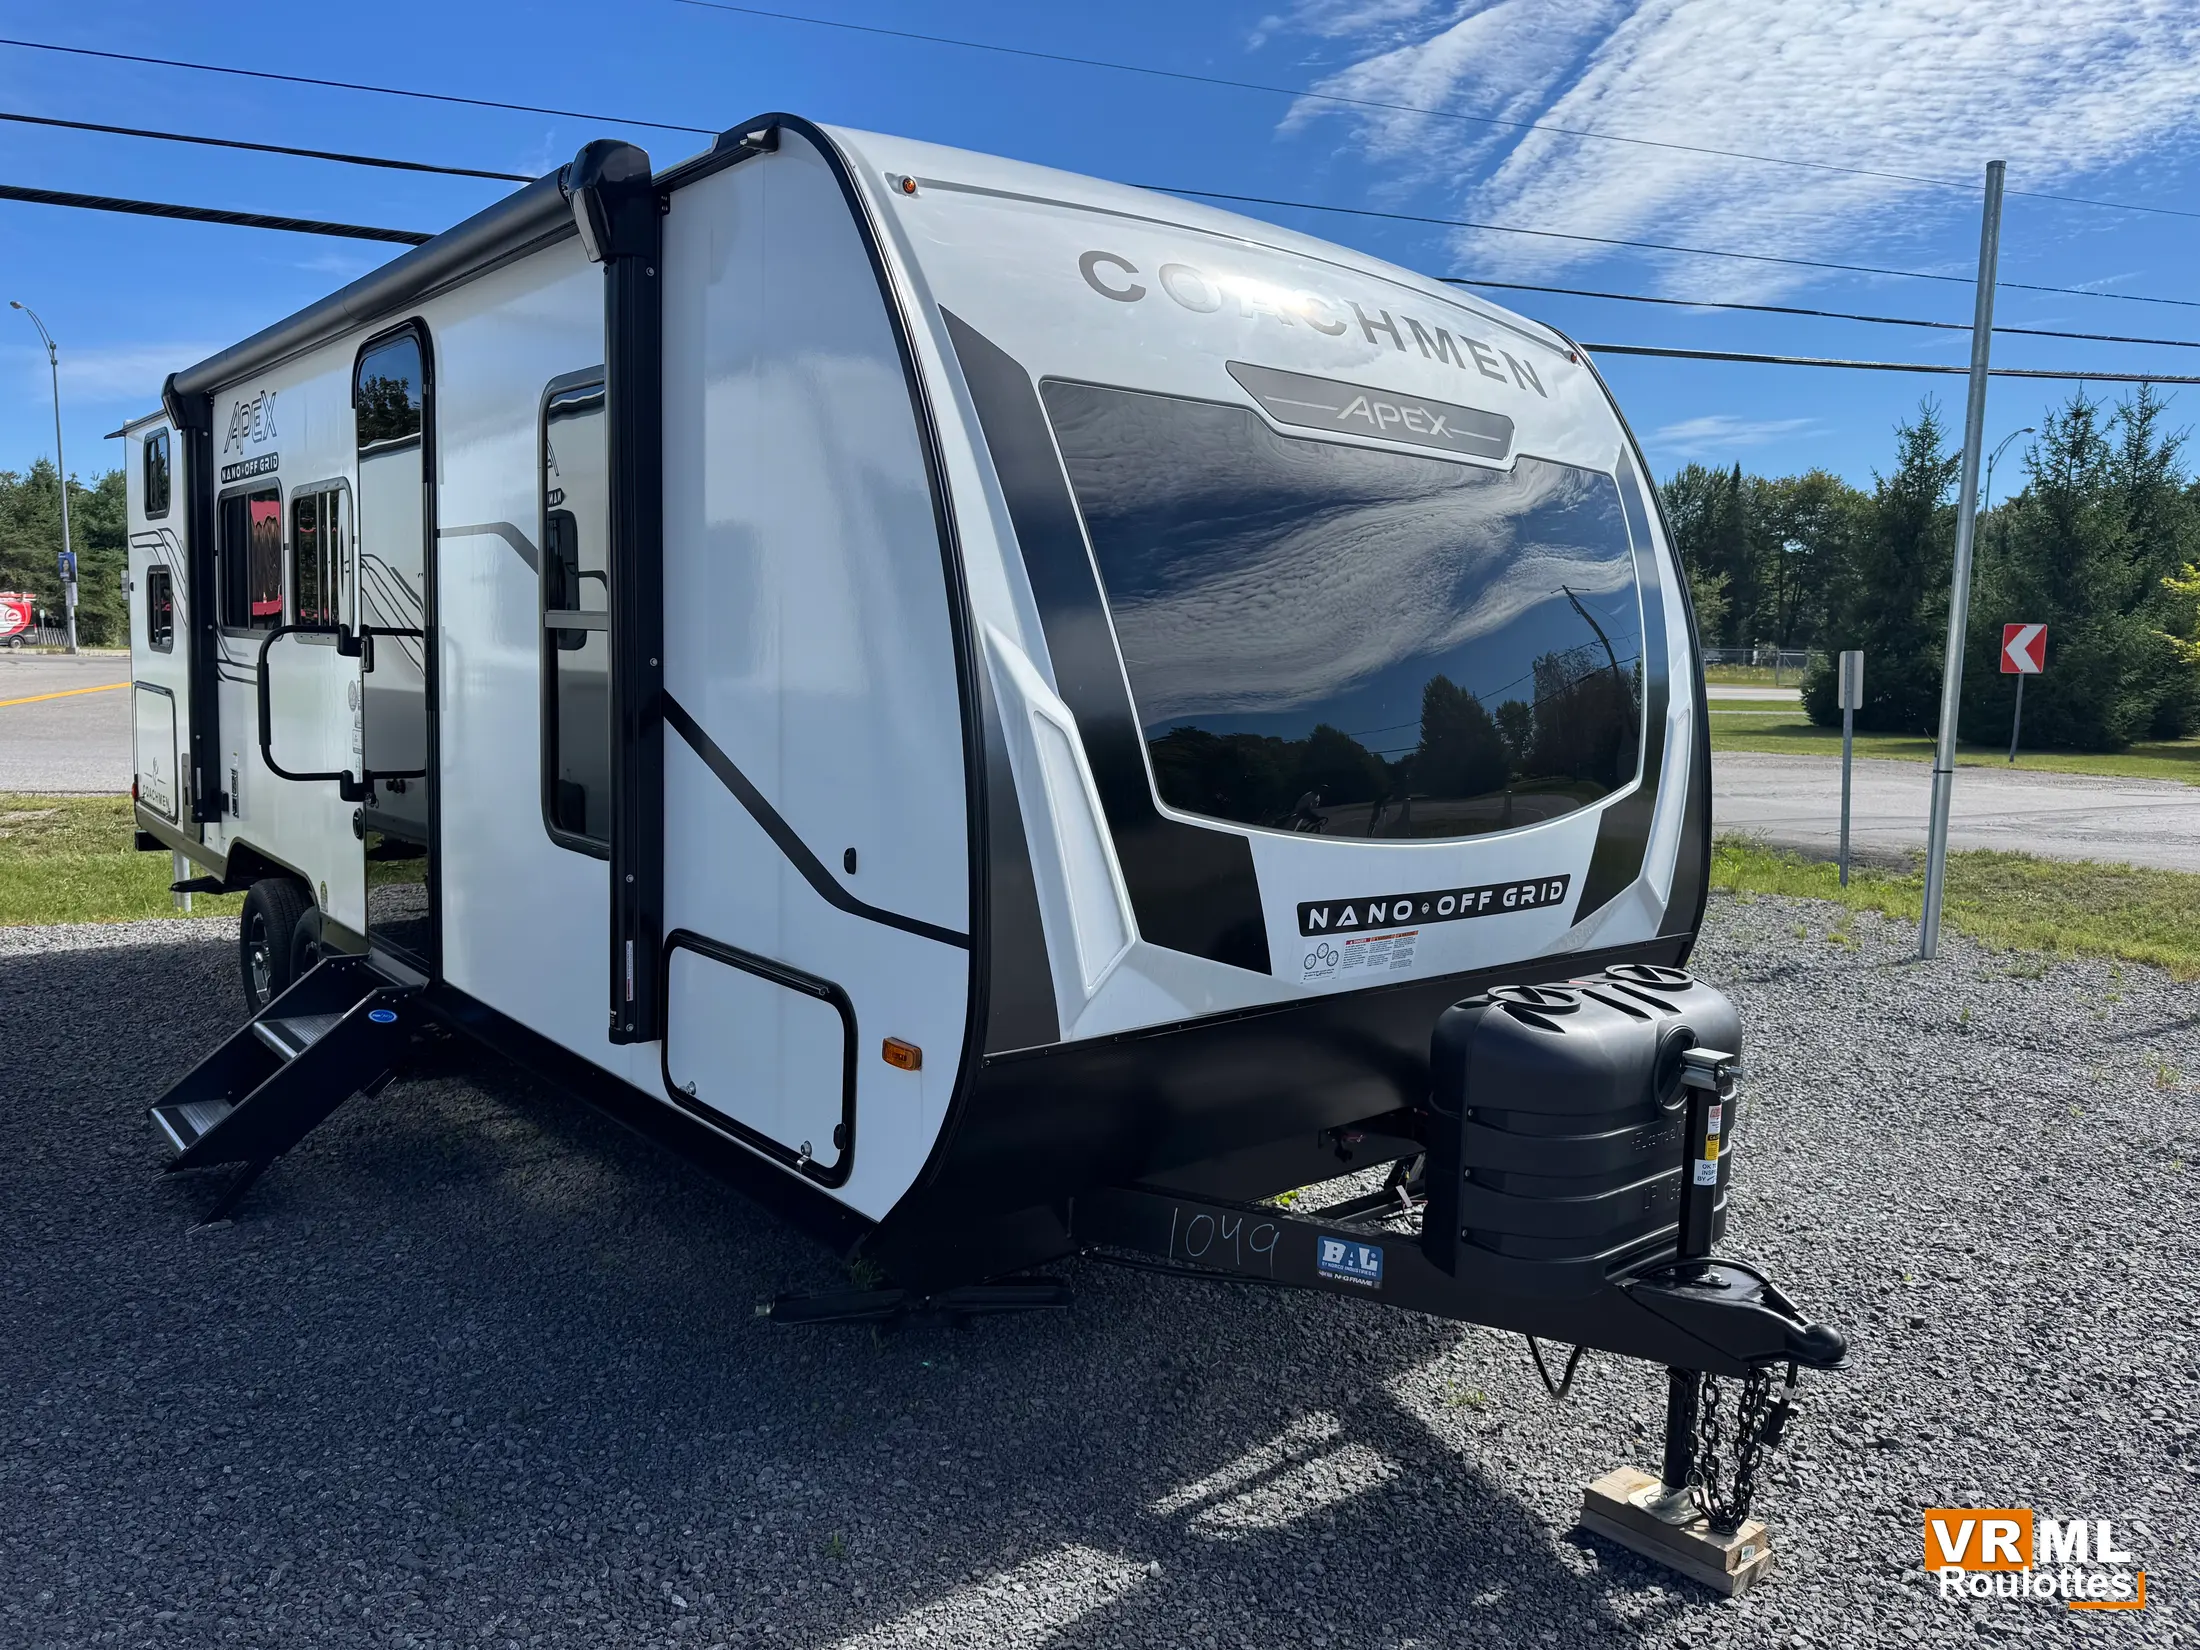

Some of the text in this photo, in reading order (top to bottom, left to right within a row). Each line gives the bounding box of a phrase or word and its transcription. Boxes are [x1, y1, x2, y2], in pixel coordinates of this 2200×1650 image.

[224, 390, 277, 455] APEX
[1336, 395, 1453, 439] APEX
[221, 455, 278, 481] NANO OFF GRID
[1308, 881, 1563, 930] NANO OFF GRID
[1168, 1207, 1280, 1278] 1049
[1322, 1240, 1378, 1271] BAL
